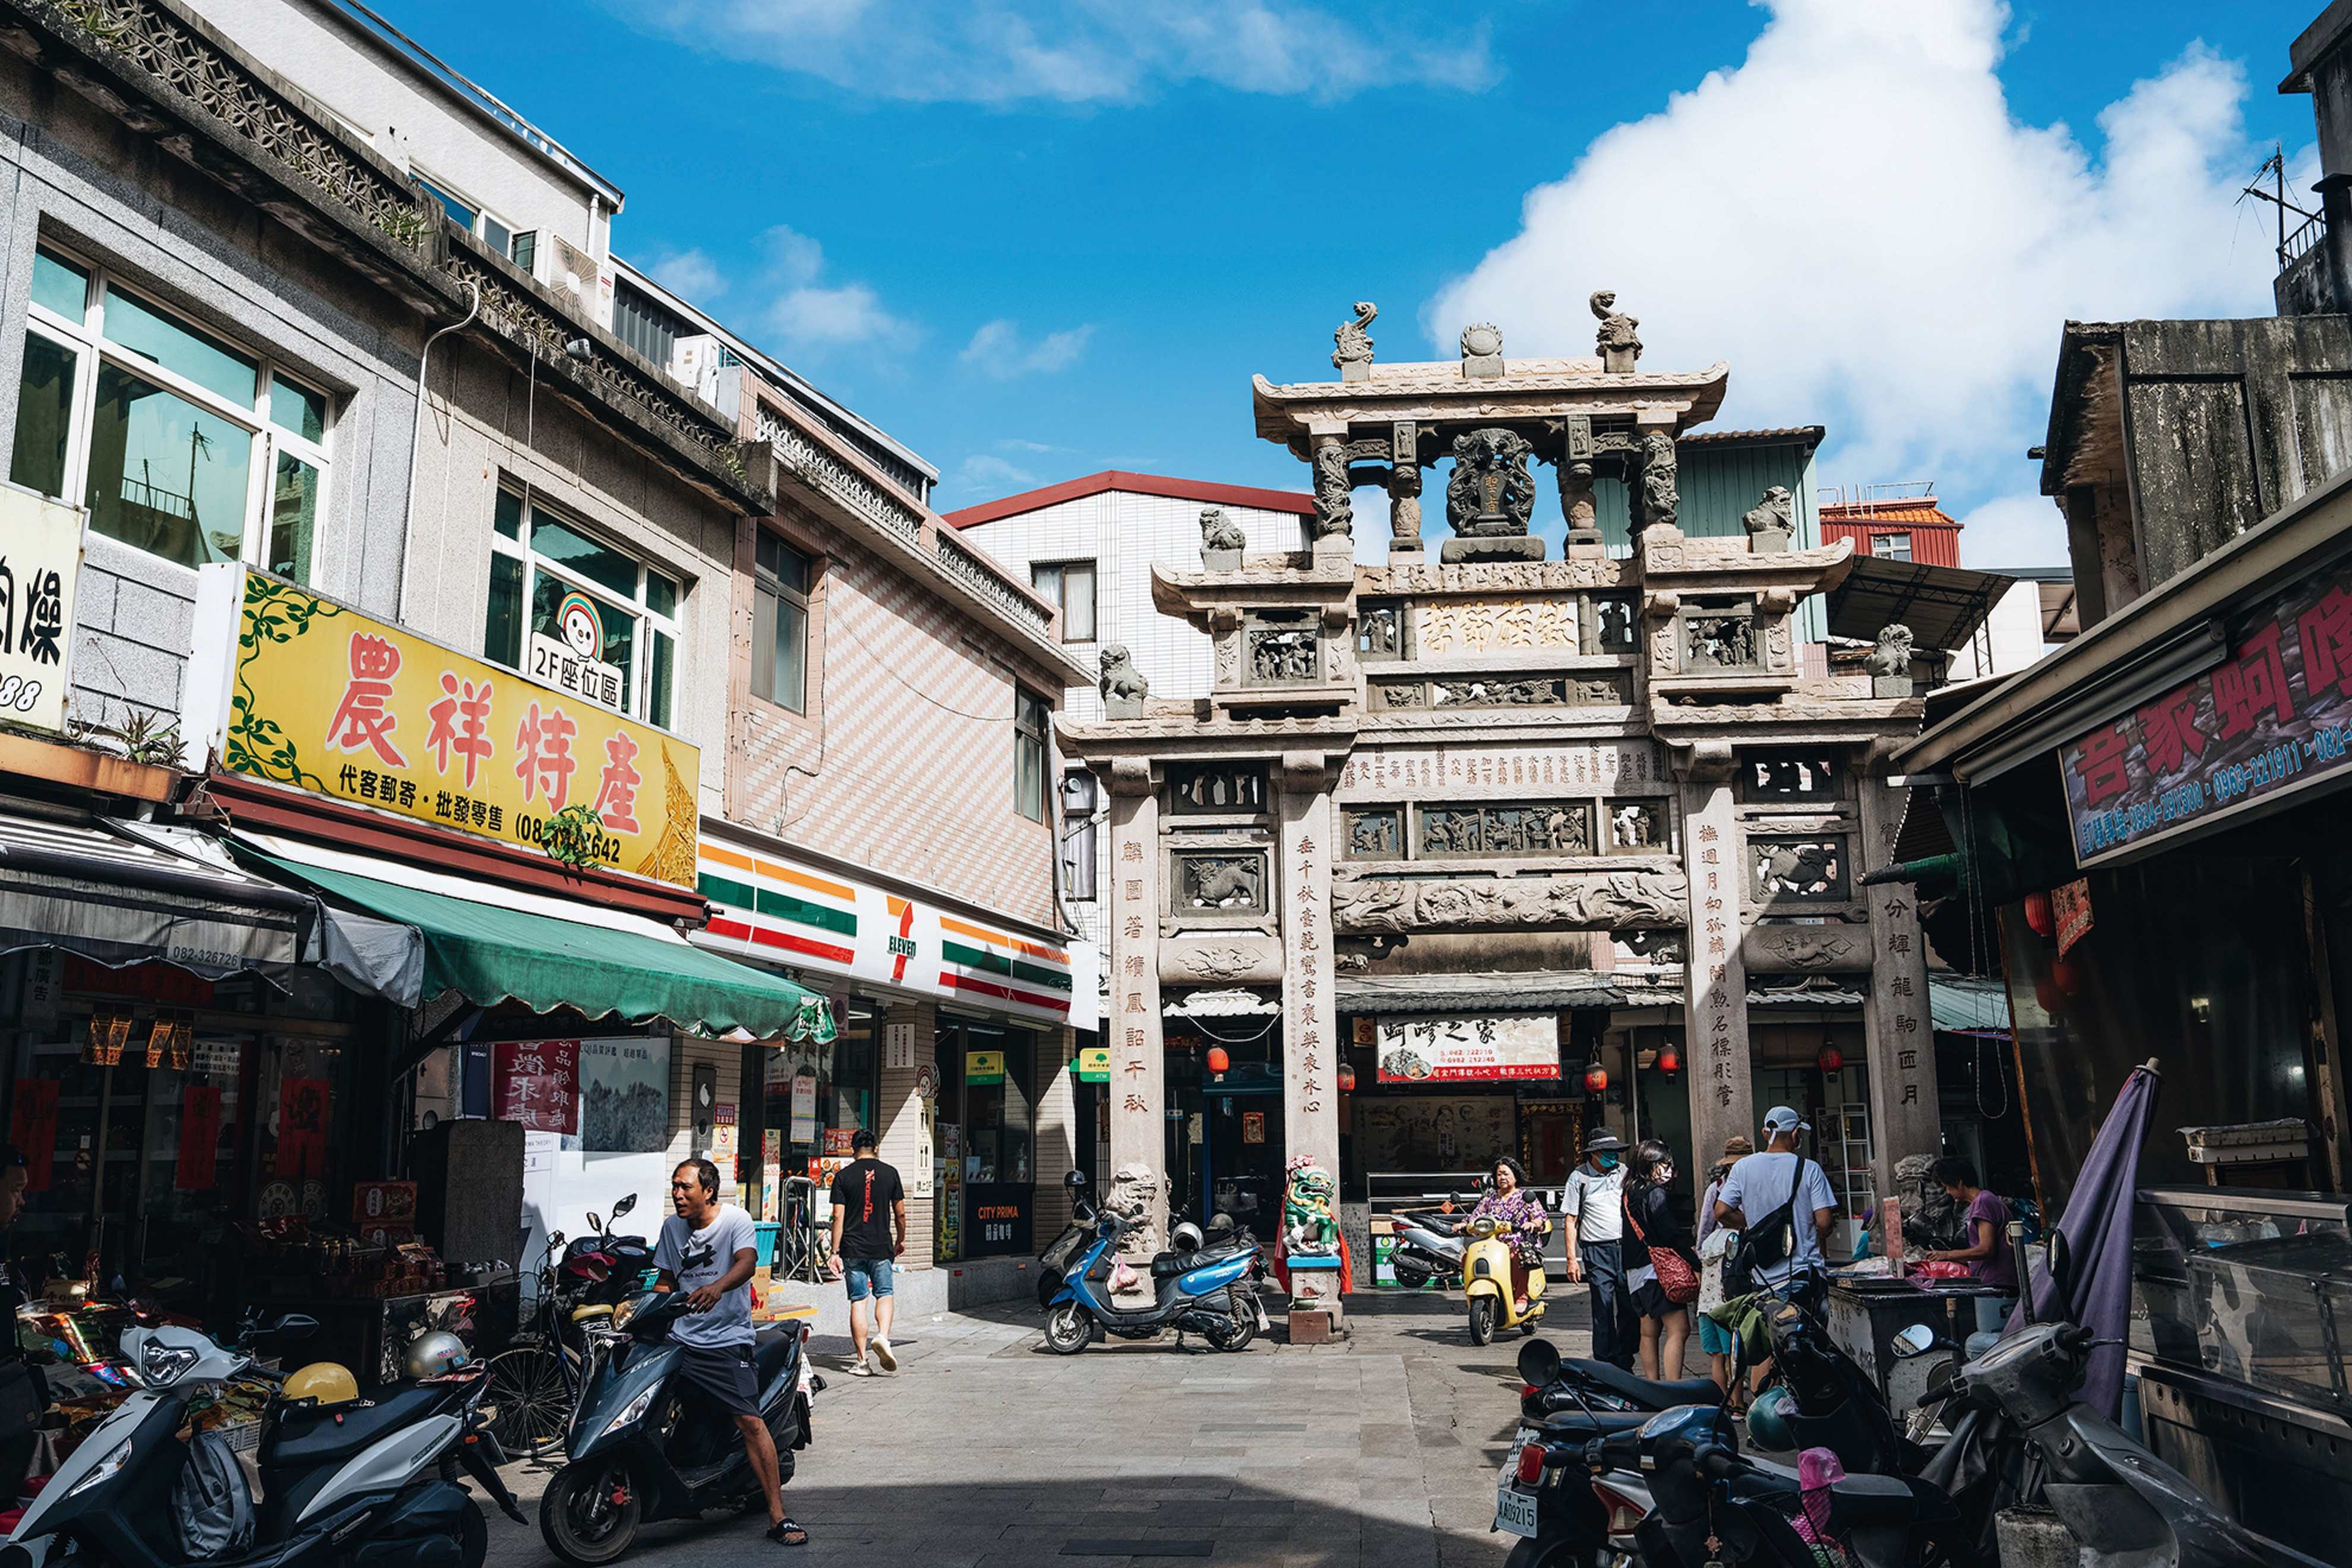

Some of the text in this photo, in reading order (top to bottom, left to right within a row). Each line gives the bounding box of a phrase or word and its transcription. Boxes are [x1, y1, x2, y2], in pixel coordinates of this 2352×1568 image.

[0, 672, 42, 712] 88
[536, 646, 618, 707] 2F座位區
[327, 631, 643, 835] 農祥特產
[2315, 718, 2352, 762] 082-
[515, 813, 619, 864] (08642
[173, 946, 238, 966] 082-326726
[978, 1205, 1019, 1220] CITY PRIMA
